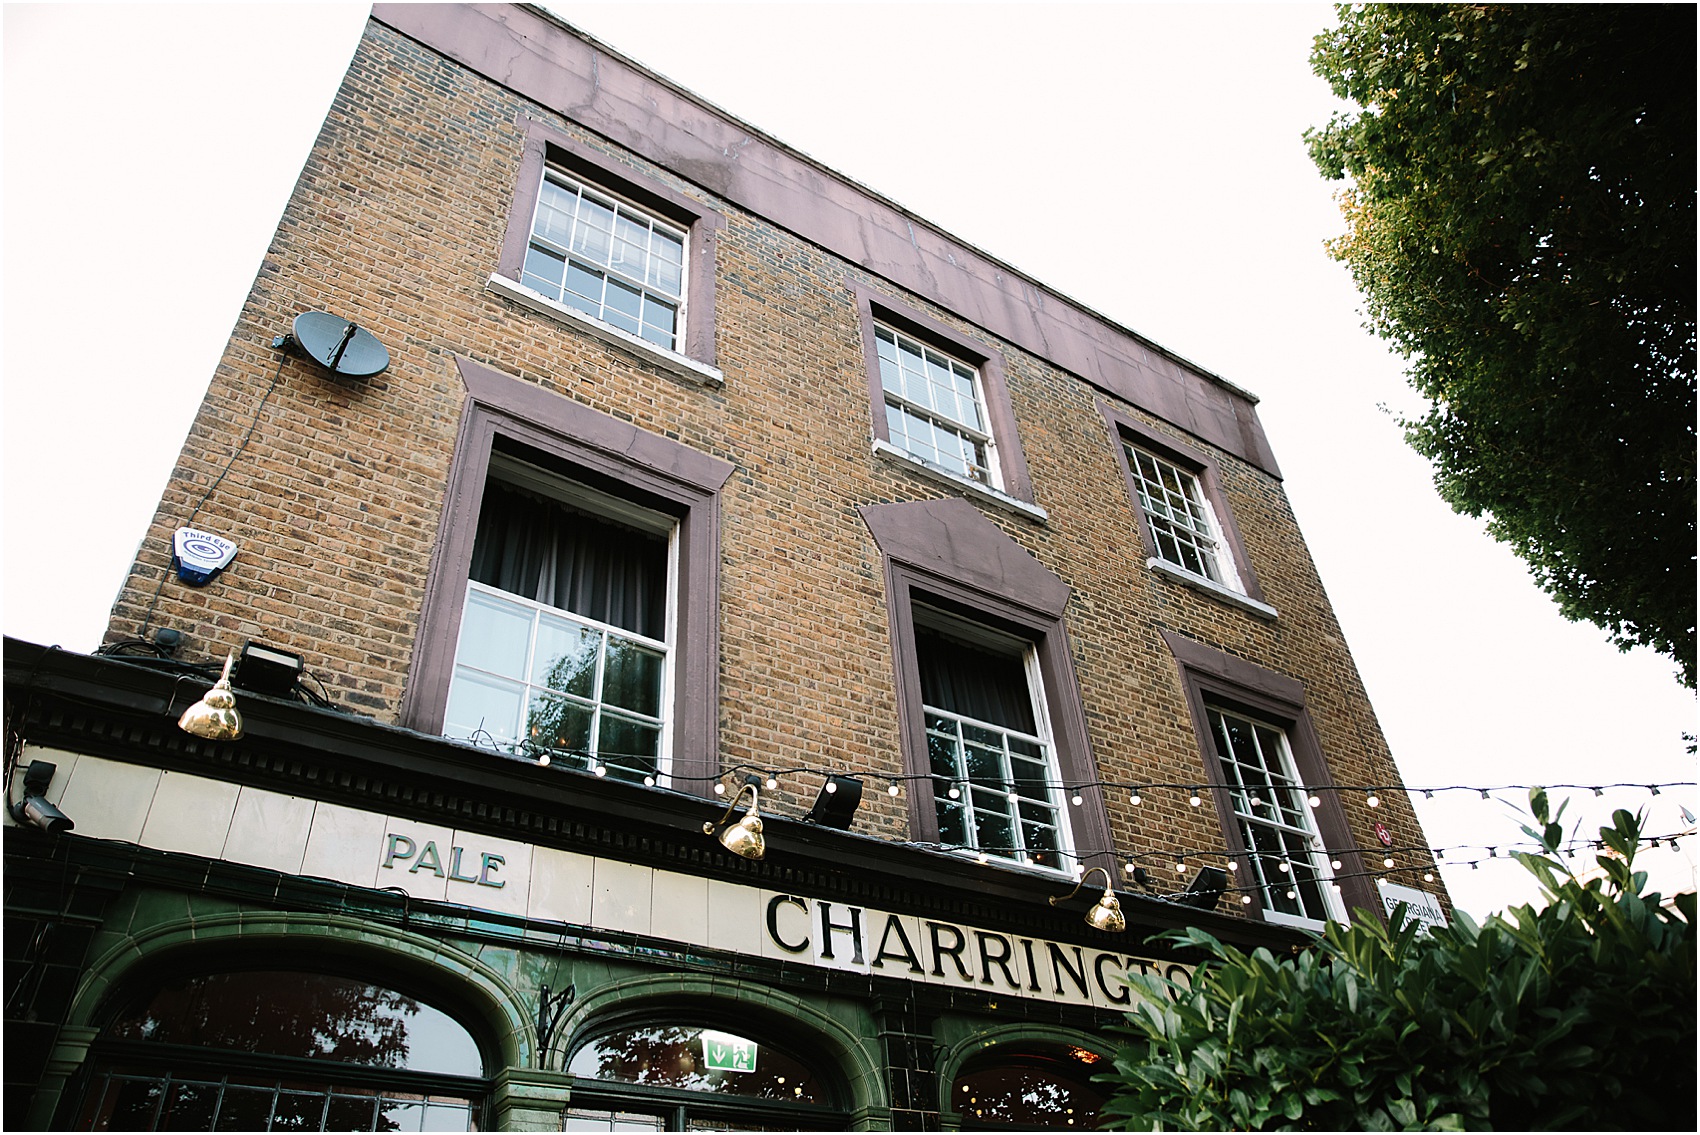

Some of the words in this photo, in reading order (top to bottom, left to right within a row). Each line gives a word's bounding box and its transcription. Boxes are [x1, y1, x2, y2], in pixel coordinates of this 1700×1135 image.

[183, 531, 212, 541] Third
[214, 538, 231, 550] Eye
[382, 833, 506, 889] PALE
[1385, 897, 1443, 922] GRGIANA
[766, 894, 1215, 1005] CHARRINGTO
